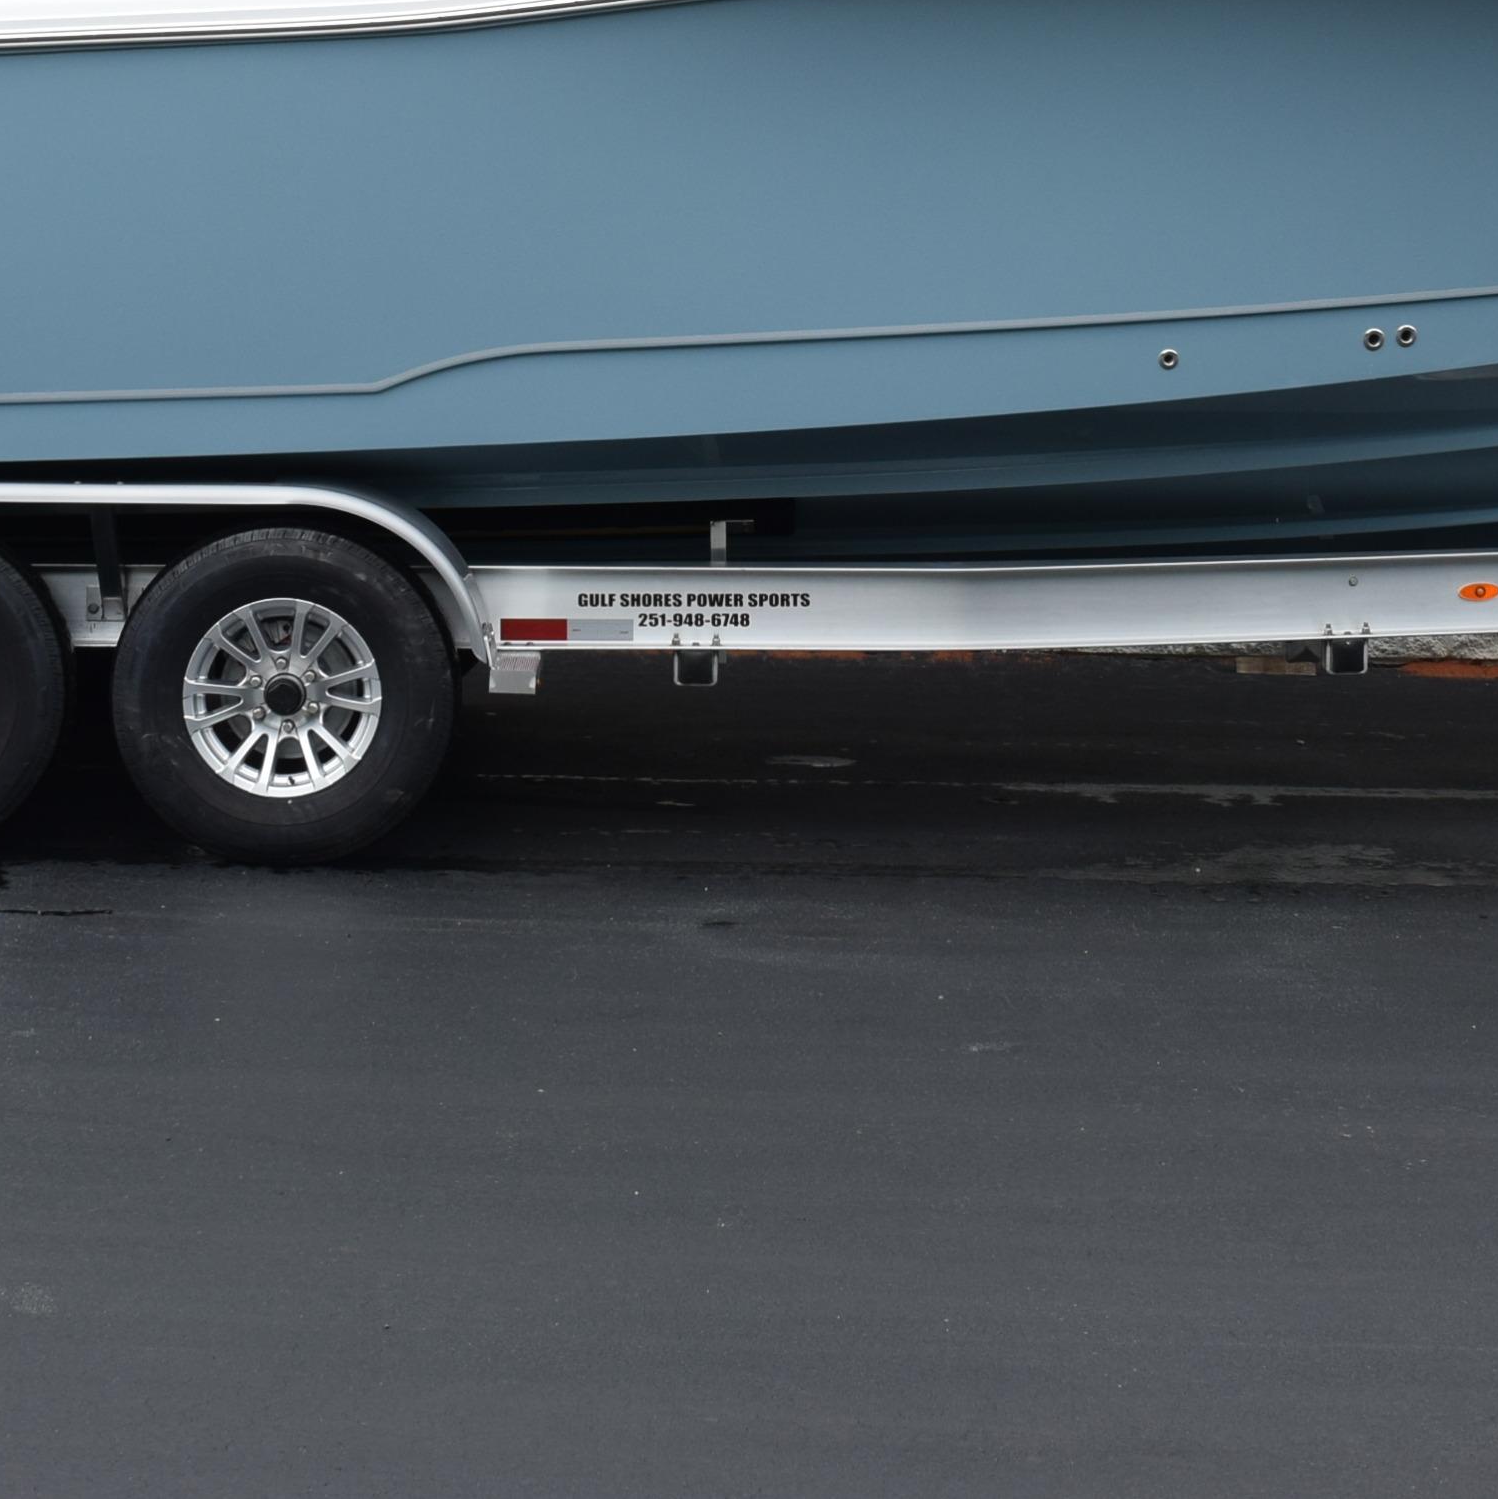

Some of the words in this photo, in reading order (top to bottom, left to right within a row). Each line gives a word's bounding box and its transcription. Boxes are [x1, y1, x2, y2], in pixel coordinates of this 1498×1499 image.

[577, 592, 617, 608] GULF
[620, 592, 683, 608] SHORES
[686, 592, 744, 608] POWER
[748, 592, 811, 608] SPORTS
[638, 613, 750, 628] 251-948-6748
